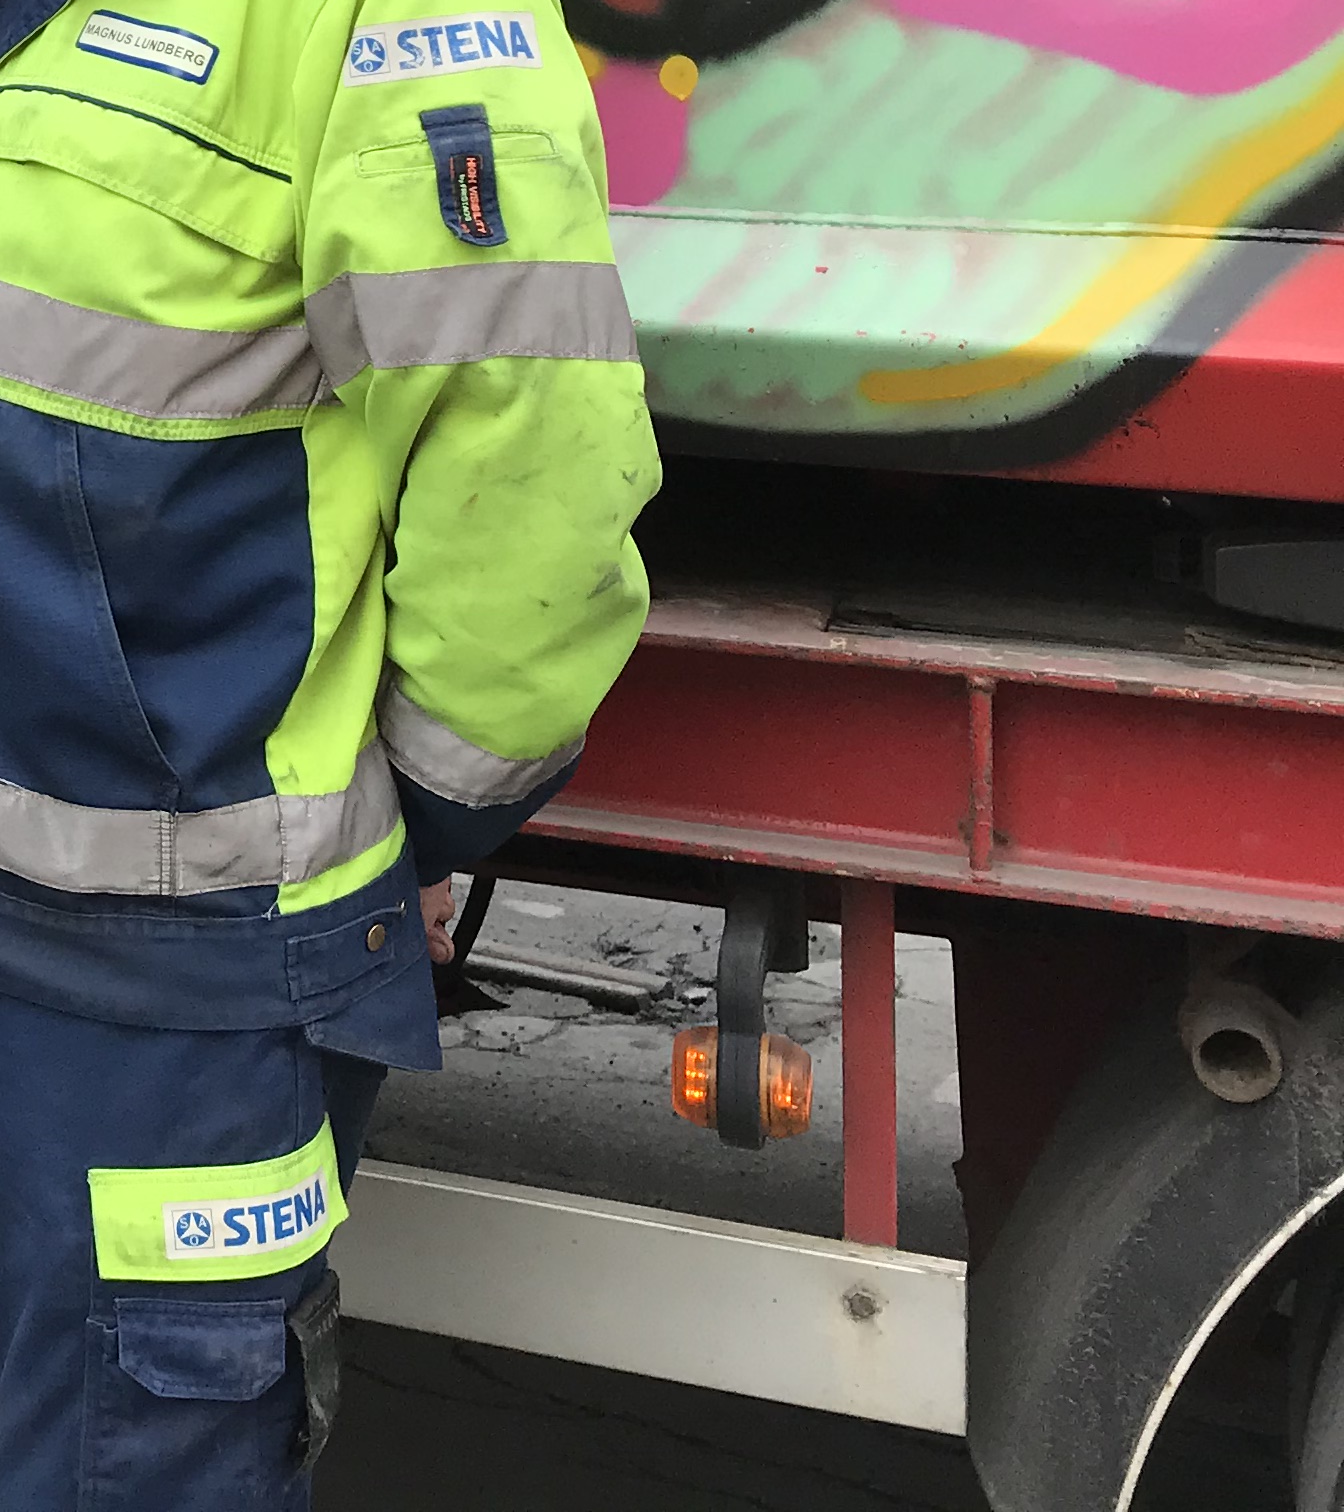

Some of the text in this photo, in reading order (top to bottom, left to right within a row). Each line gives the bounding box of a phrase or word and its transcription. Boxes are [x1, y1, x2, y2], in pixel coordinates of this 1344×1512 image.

[84, 23, 205, 68] MAGNUS LUNDBERG
[396, 19, 535, 70] STENA
[465, 156, 488, 234] HIGH VISIBILITY
[223, 1179, 326, 1248] STENA
